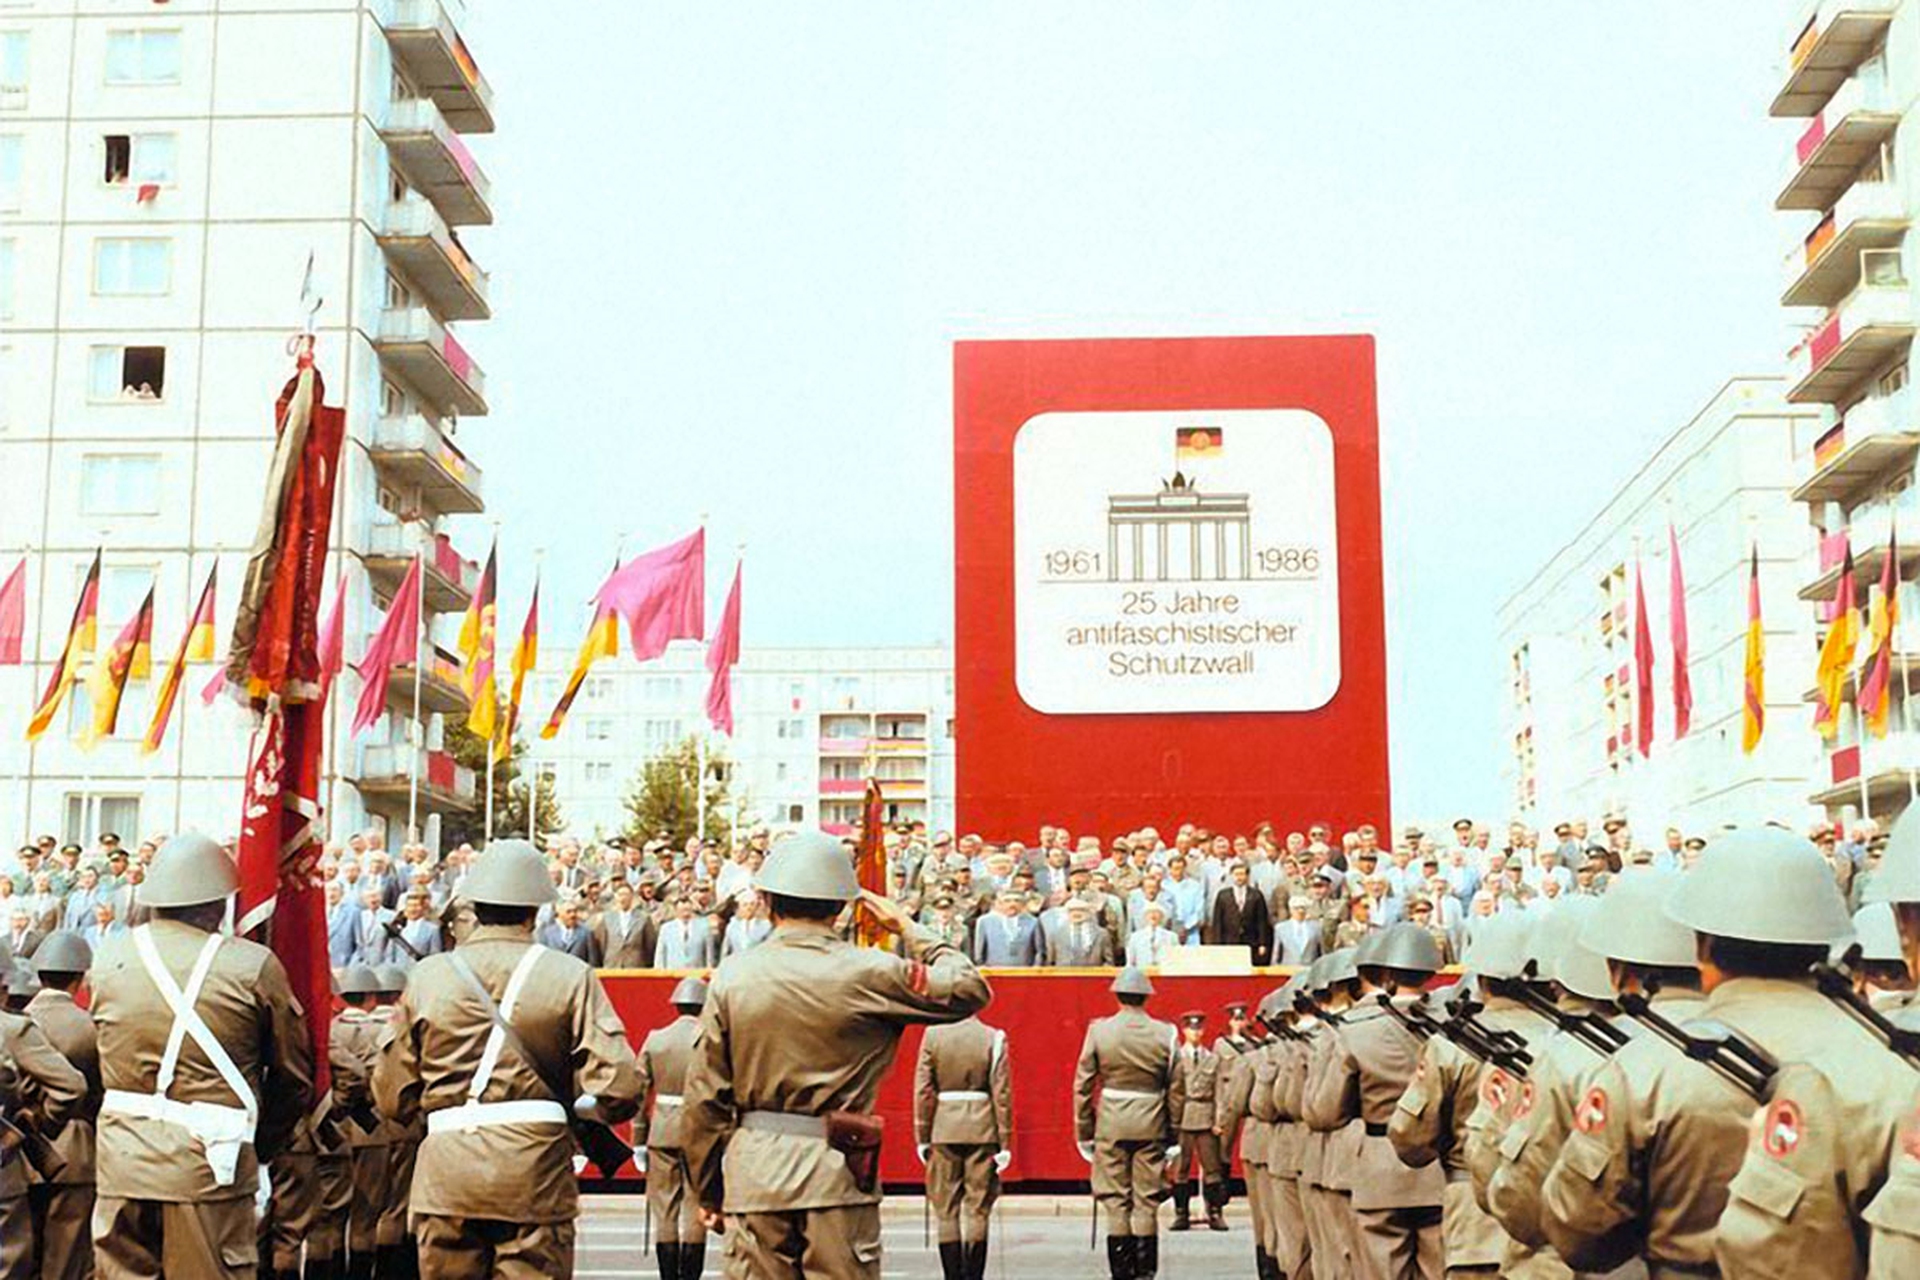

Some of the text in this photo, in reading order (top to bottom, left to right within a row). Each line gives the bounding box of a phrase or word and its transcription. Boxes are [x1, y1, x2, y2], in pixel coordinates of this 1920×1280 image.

[1045, 548, 1319, 575] 1961 1986
[1122, 591, 1239, 615] 25 Jahre
[1067, 619, 1296, 645] antifaschistischer
[1109, 651, 1254, 676] Schutzwall
